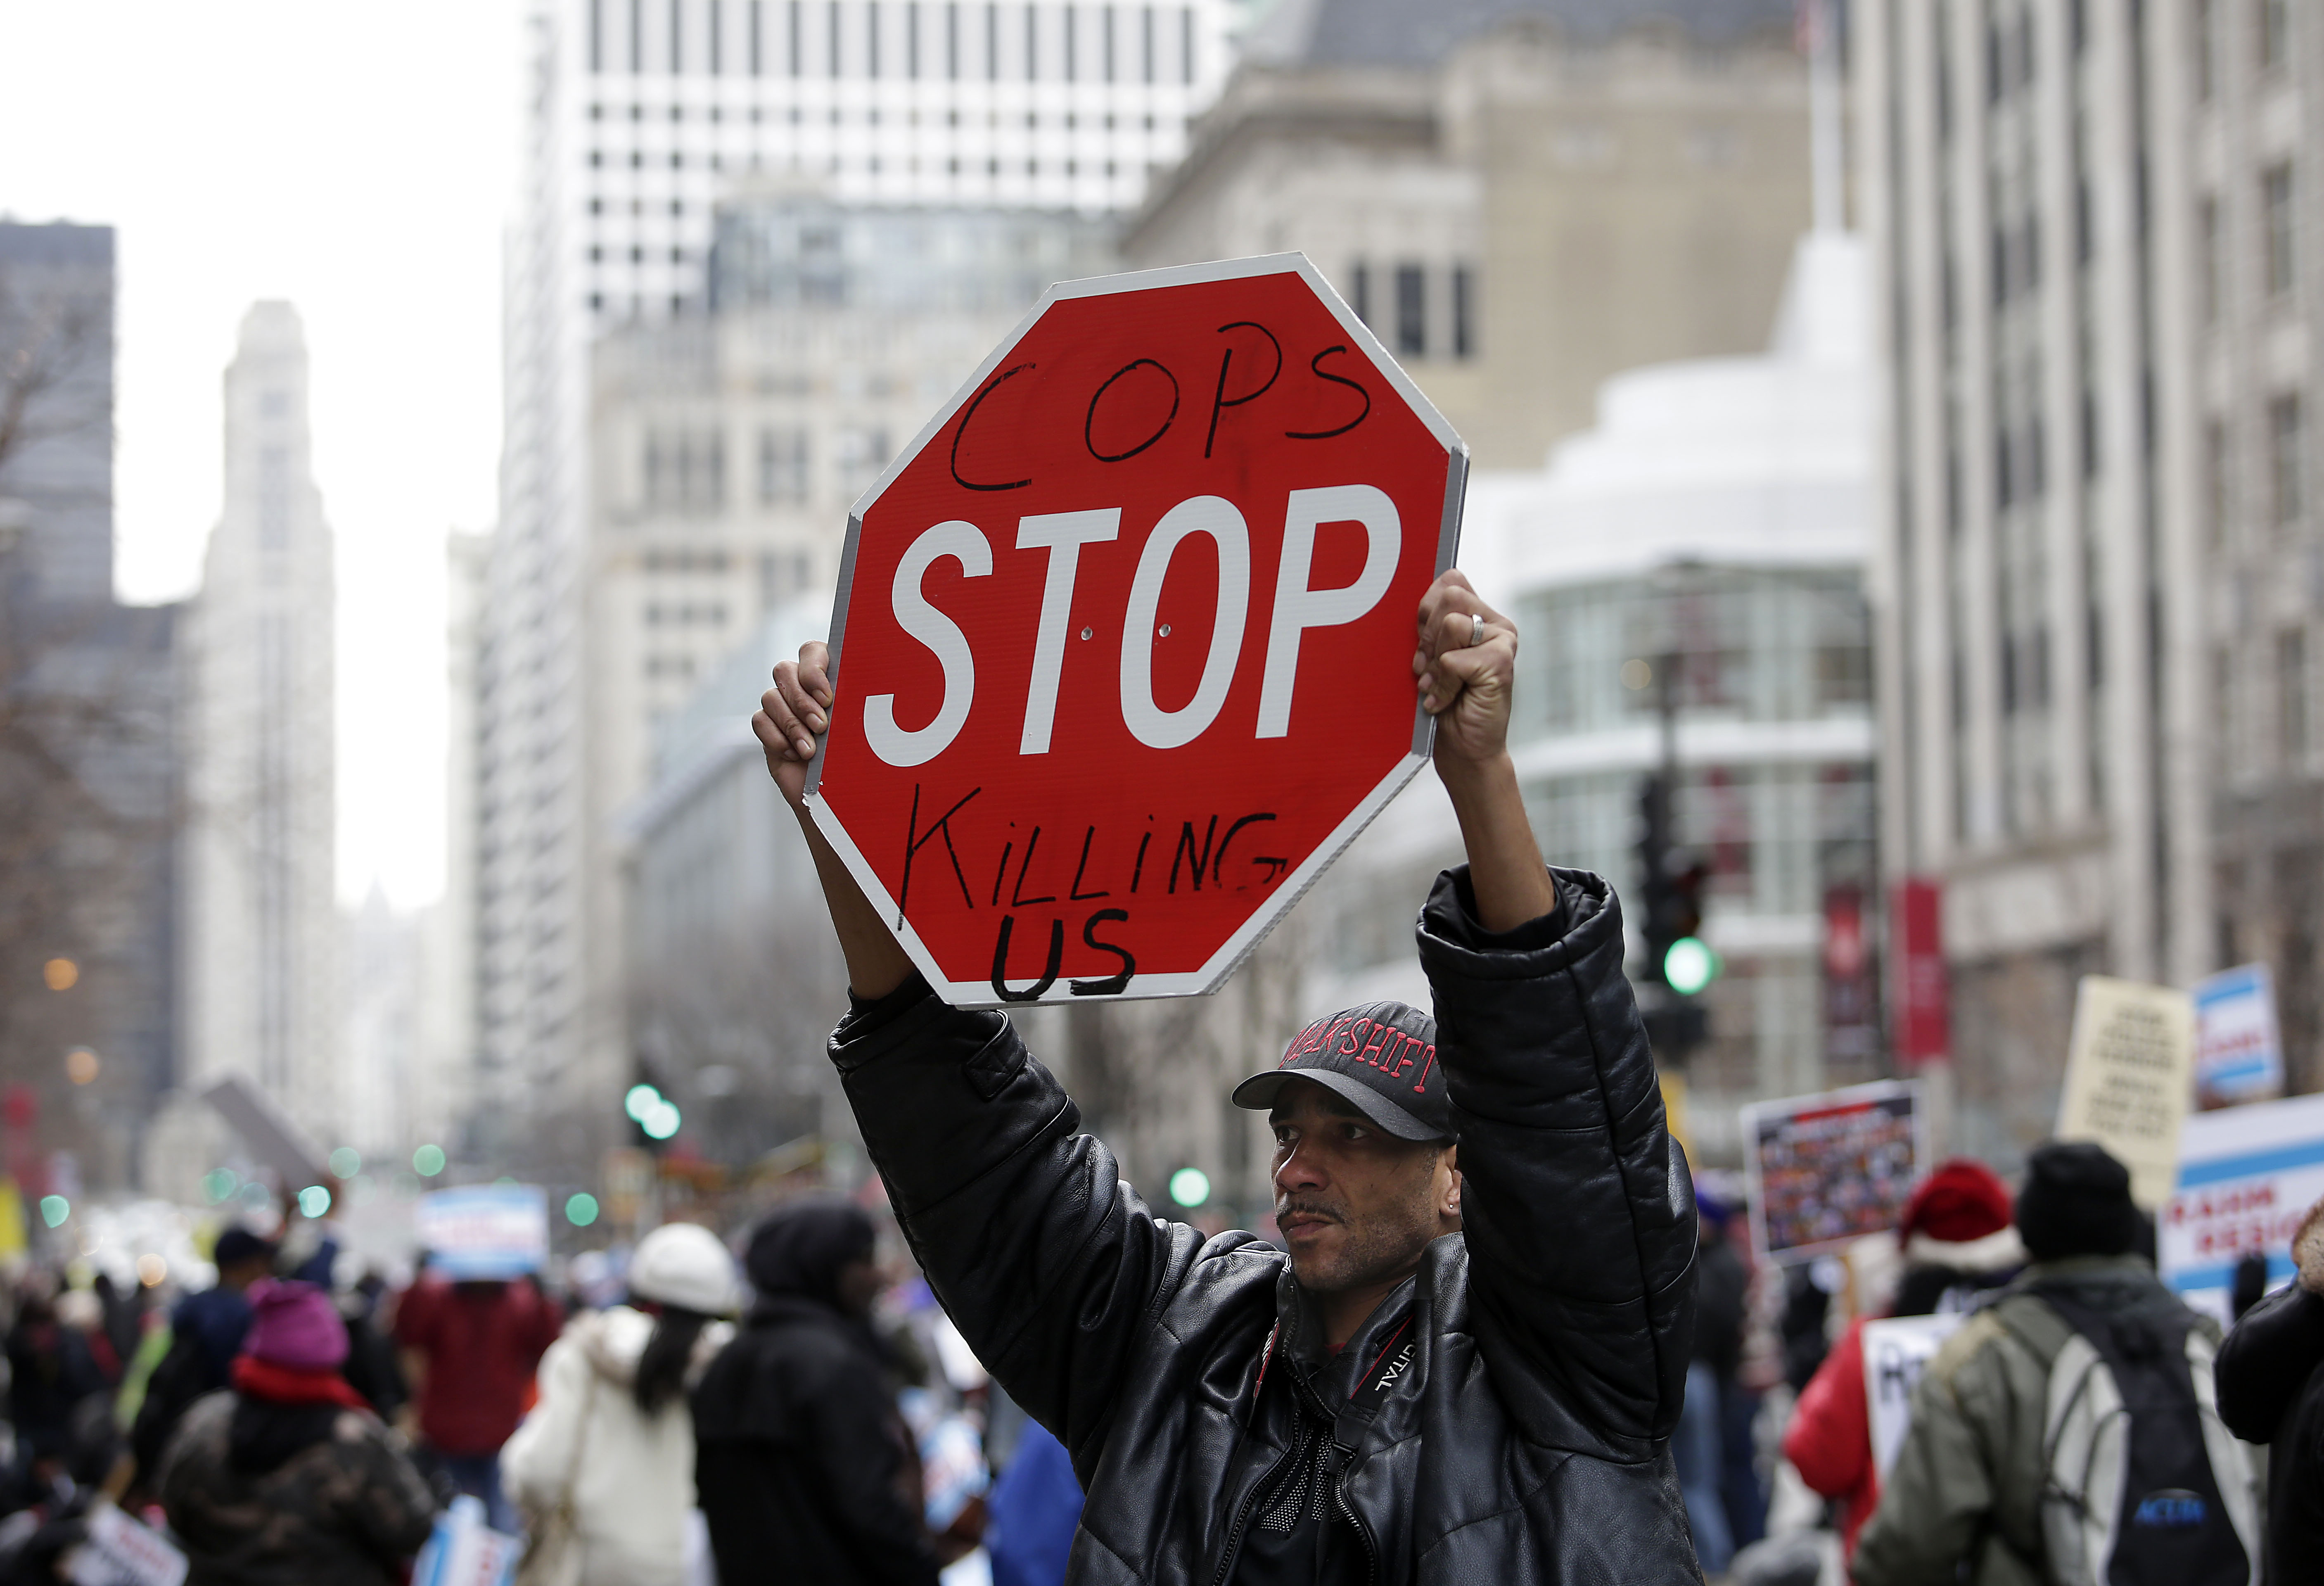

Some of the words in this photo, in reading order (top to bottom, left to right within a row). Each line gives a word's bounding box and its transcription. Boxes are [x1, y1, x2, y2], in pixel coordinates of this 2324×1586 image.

[951, 322, 1370, 491] COPS
[863, 484, 1402, 767] STOP
[991, 909, 1136, 1002] US
